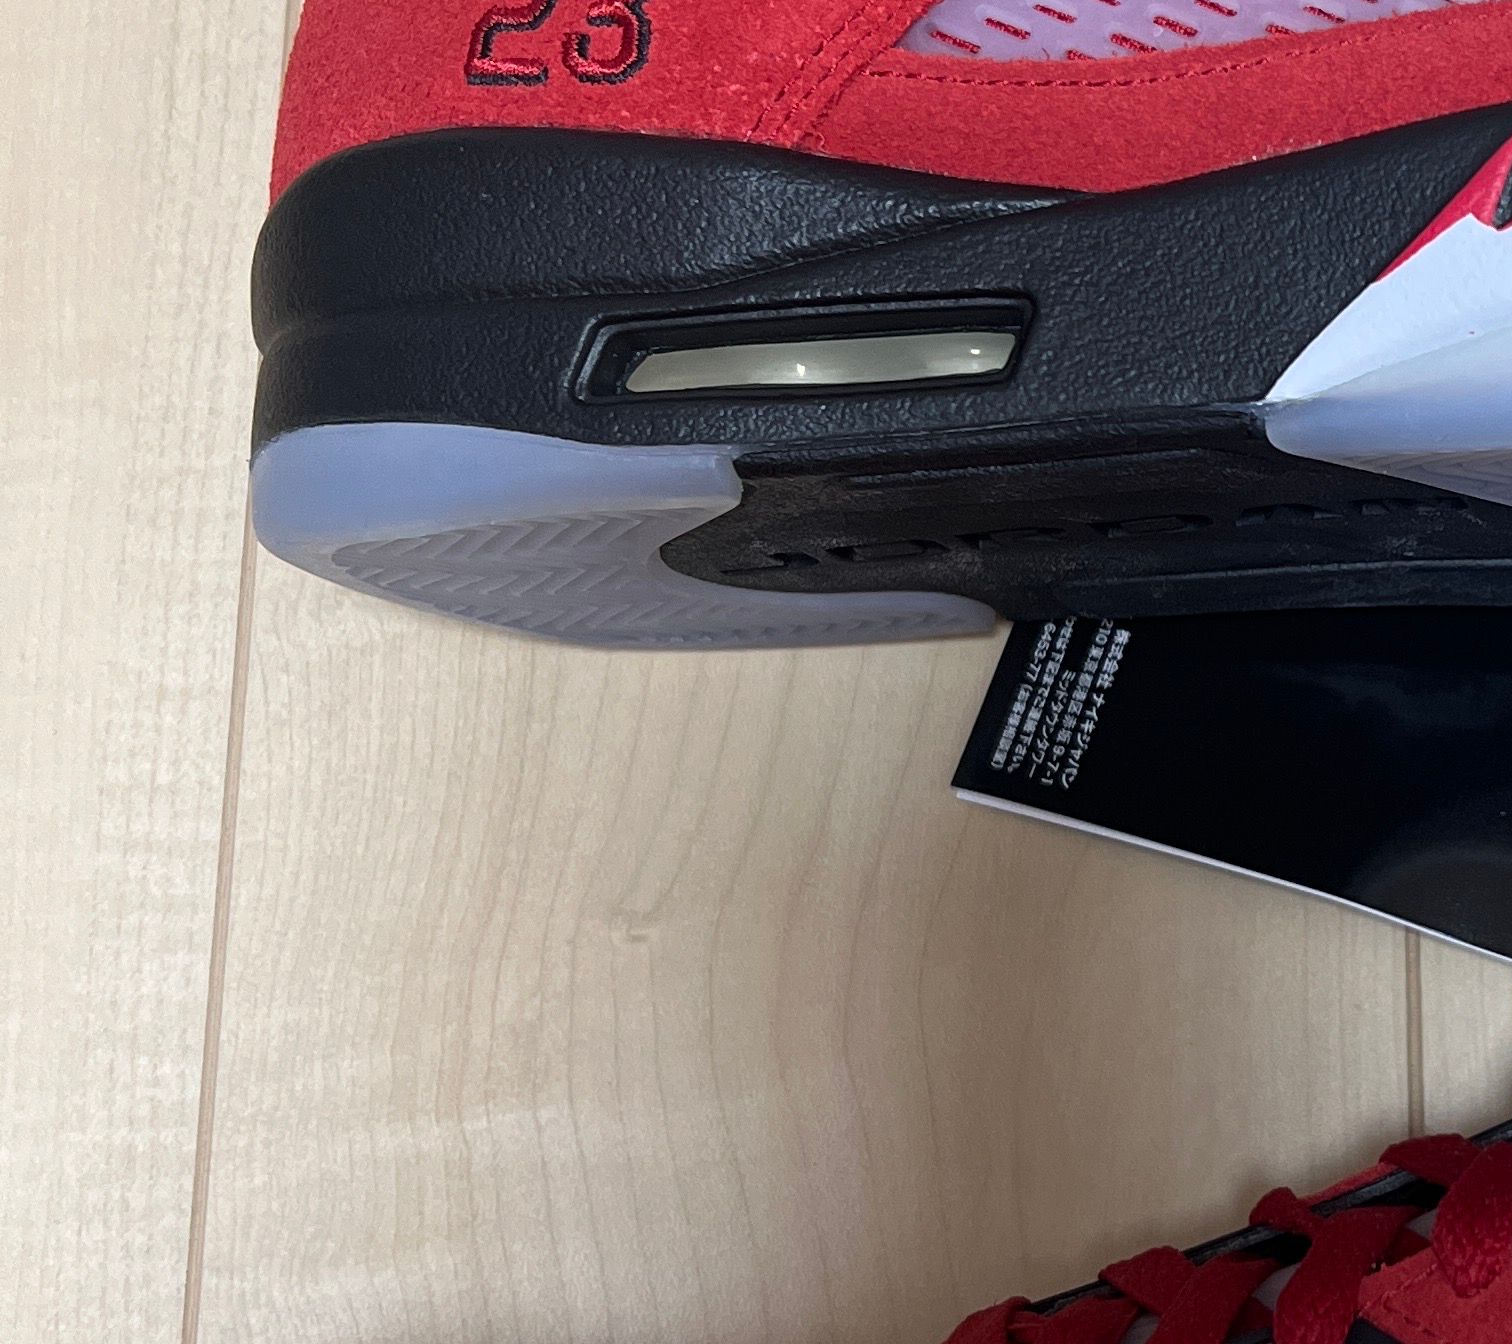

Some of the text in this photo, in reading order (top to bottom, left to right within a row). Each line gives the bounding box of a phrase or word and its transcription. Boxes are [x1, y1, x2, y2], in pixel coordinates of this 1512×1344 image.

[1028, 669, 1075, 778] ミッドタウンタワー
[1061, 629, 1131, 790] 株式会社 ナイキジャパン
